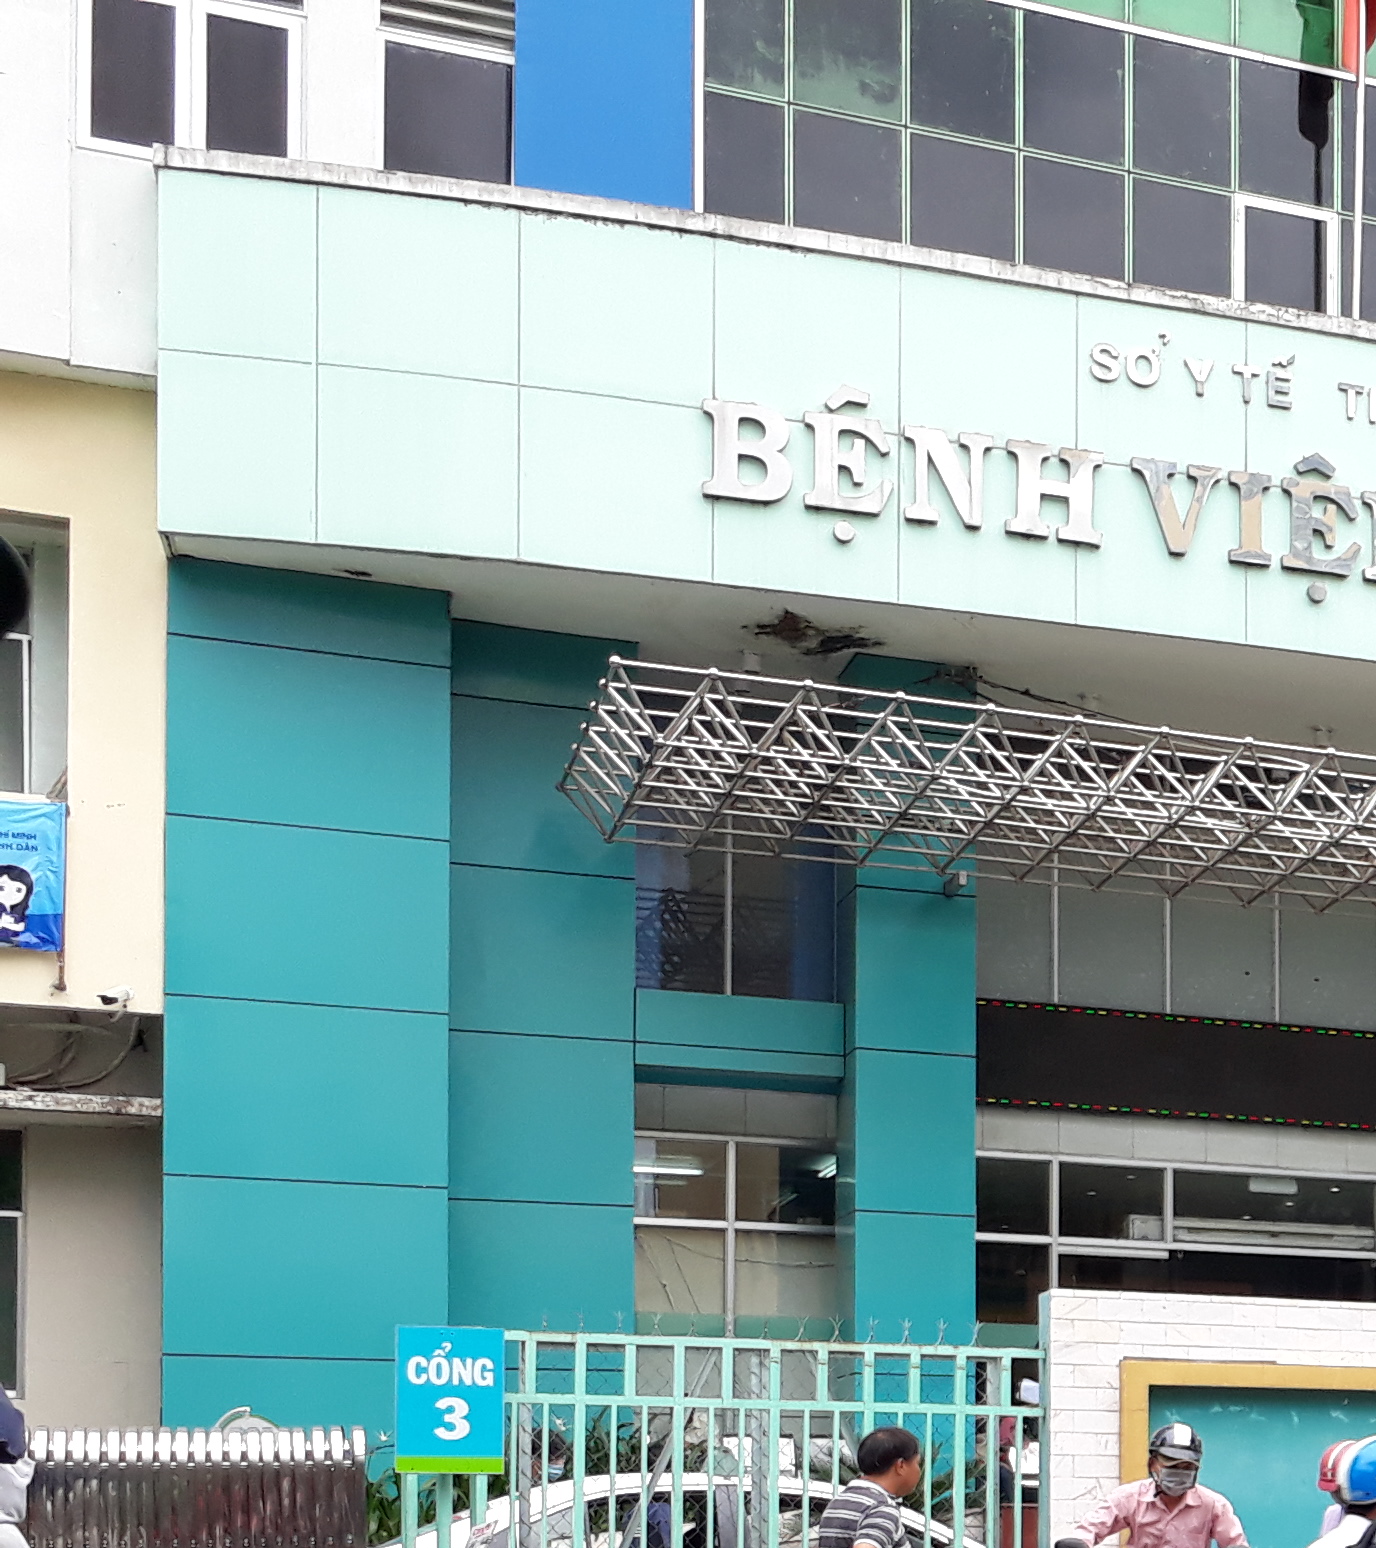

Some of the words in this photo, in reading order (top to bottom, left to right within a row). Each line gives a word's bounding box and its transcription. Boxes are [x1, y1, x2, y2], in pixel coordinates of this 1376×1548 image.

[1089, 332, 1171, 388] SỞ
[1183, 356, 1215, 398] Y
[1231, 352, 1296, 411] TẾ
[701, 384, 1105, 549] BỆNH
[406, 1341, 495, 1387] CỔNG
[433, 1396, 471, 1441] 3
